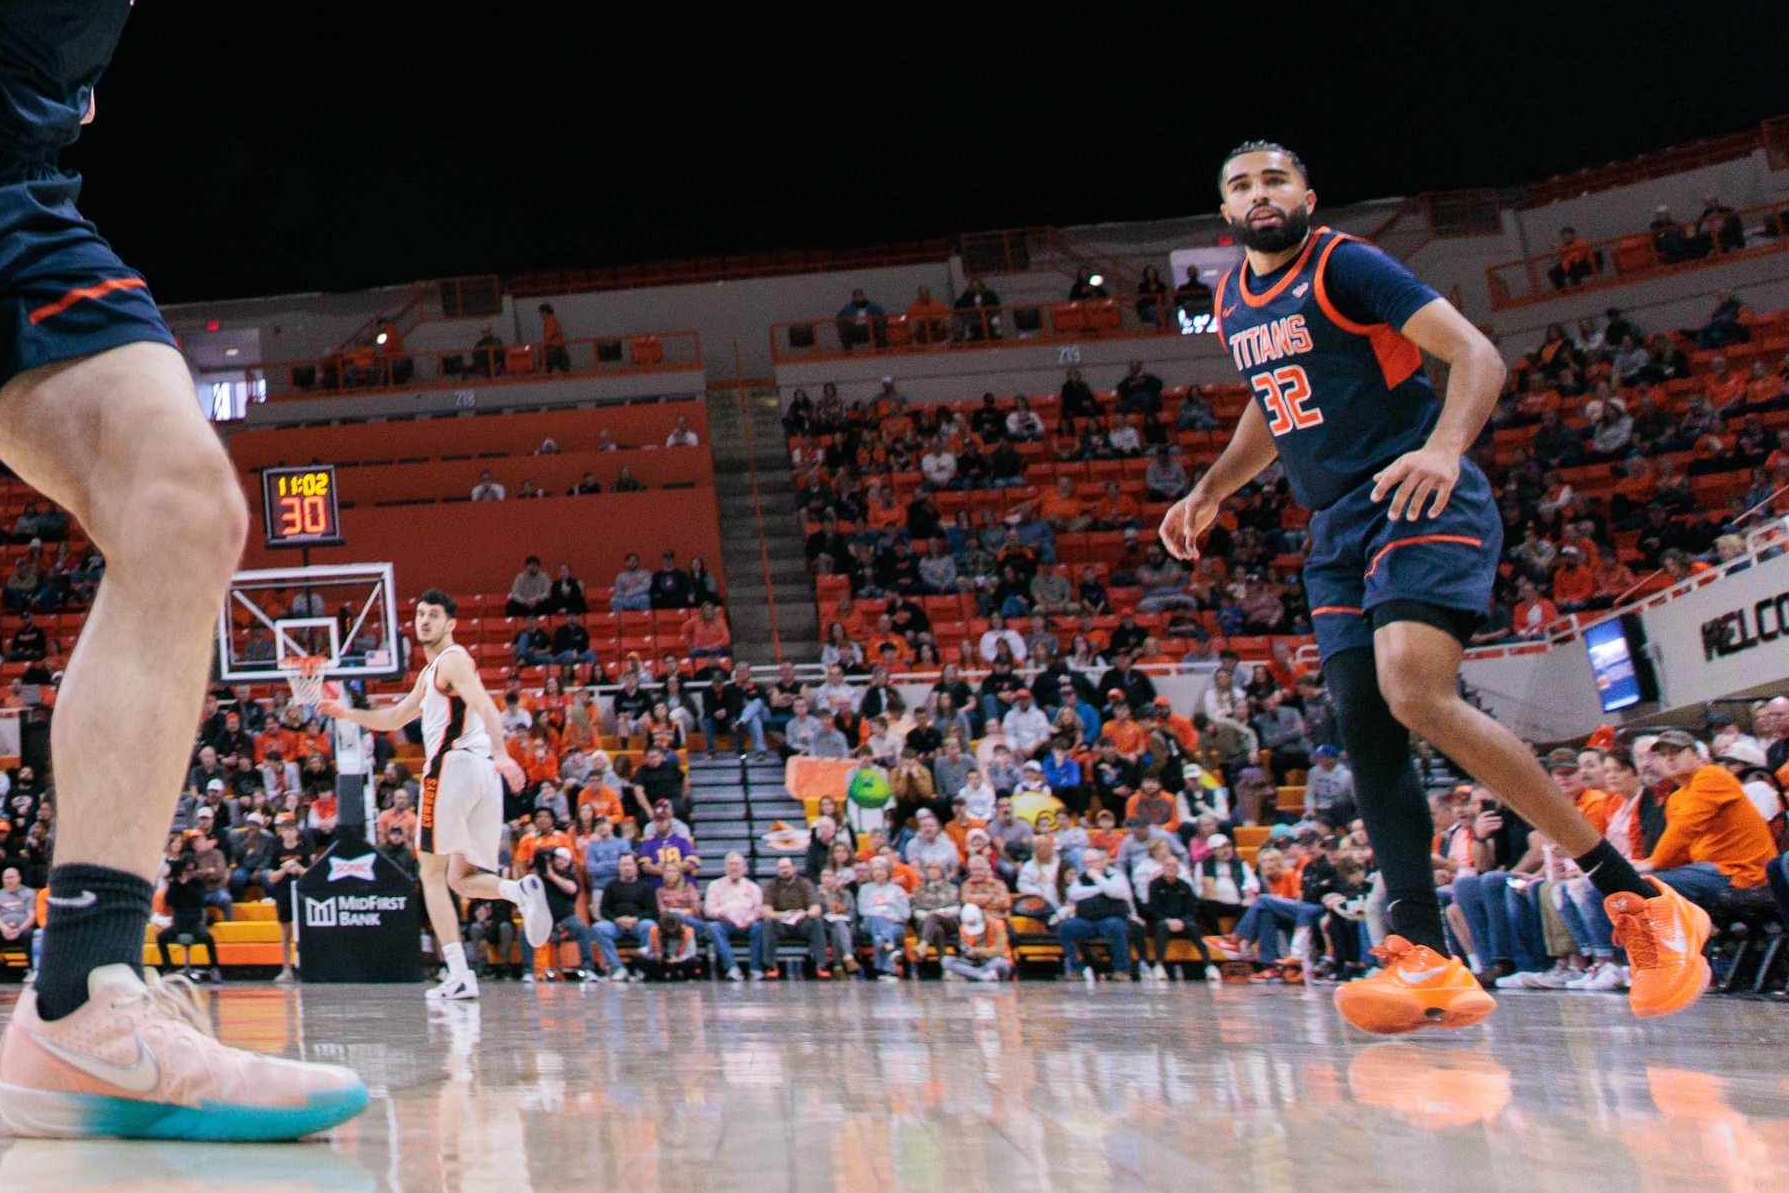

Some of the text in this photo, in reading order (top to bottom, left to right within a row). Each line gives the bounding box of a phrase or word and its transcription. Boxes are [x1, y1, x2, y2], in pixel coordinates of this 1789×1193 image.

[1229, 313, 1314, 372] TITANS
[1250, 363, 1325, 438] 32
[278, 471, 330, 497] 11:02
[279, 495, 328, 536] 30
